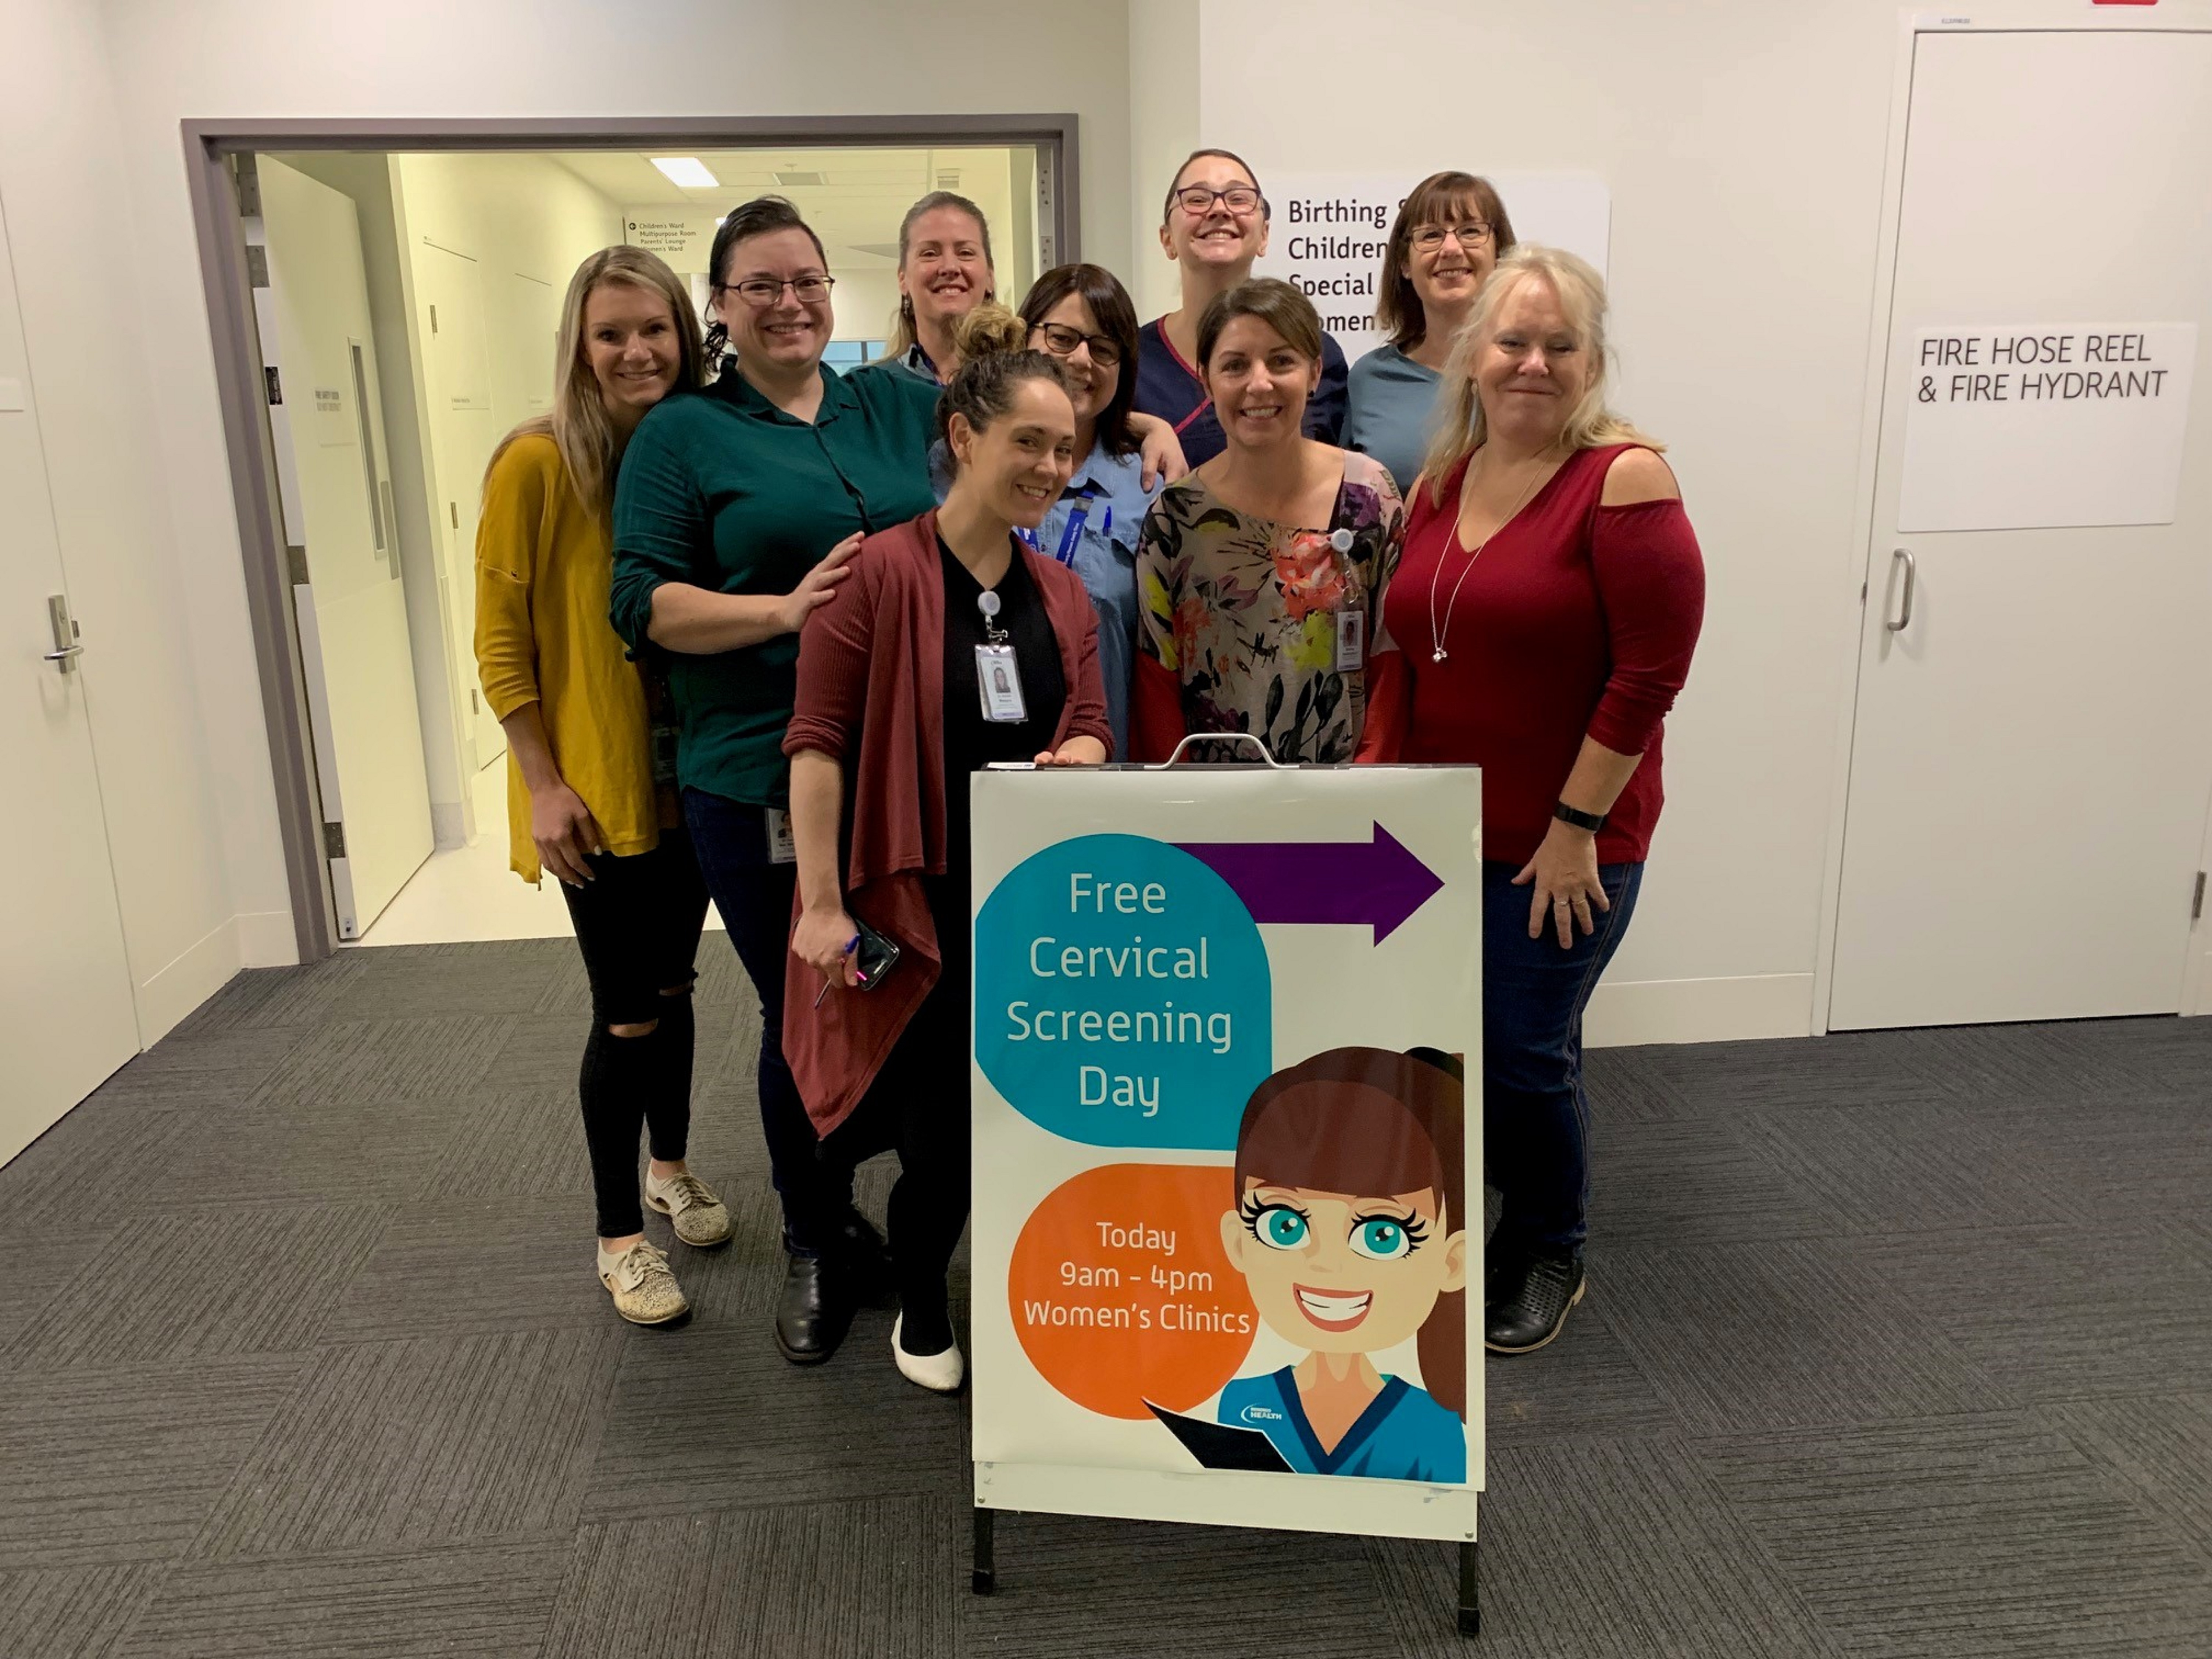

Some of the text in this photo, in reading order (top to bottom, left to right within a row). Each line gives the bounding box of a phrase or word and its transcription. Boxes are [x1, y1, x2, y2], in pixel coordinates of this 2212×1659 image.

[1289, 199, 1388, 229] Birthing
[1289, 272, 1374, 296] Special
[1921, 334, 2152, 366] FIRE HOSE REEL
[1917, 370, 2169, 403] & FIRE HYDRANT
[1070, 873, 1166, 914] Free
[1030, 936, 1209, 979] Cervical
[1006, 1001, 1232, 1055] Screening
[1080, 1066, 1160, 1118] Day
[1096, 1221, 1176, 1256] Today
[1060, 1261, 1119, 1287] 9am
[1150, 1264, 1213, 1296] 4pm
[1024, 1300, 1251, 1334] Women's Clinics
[1251, 1412, 1282, 1420] HEALTH
